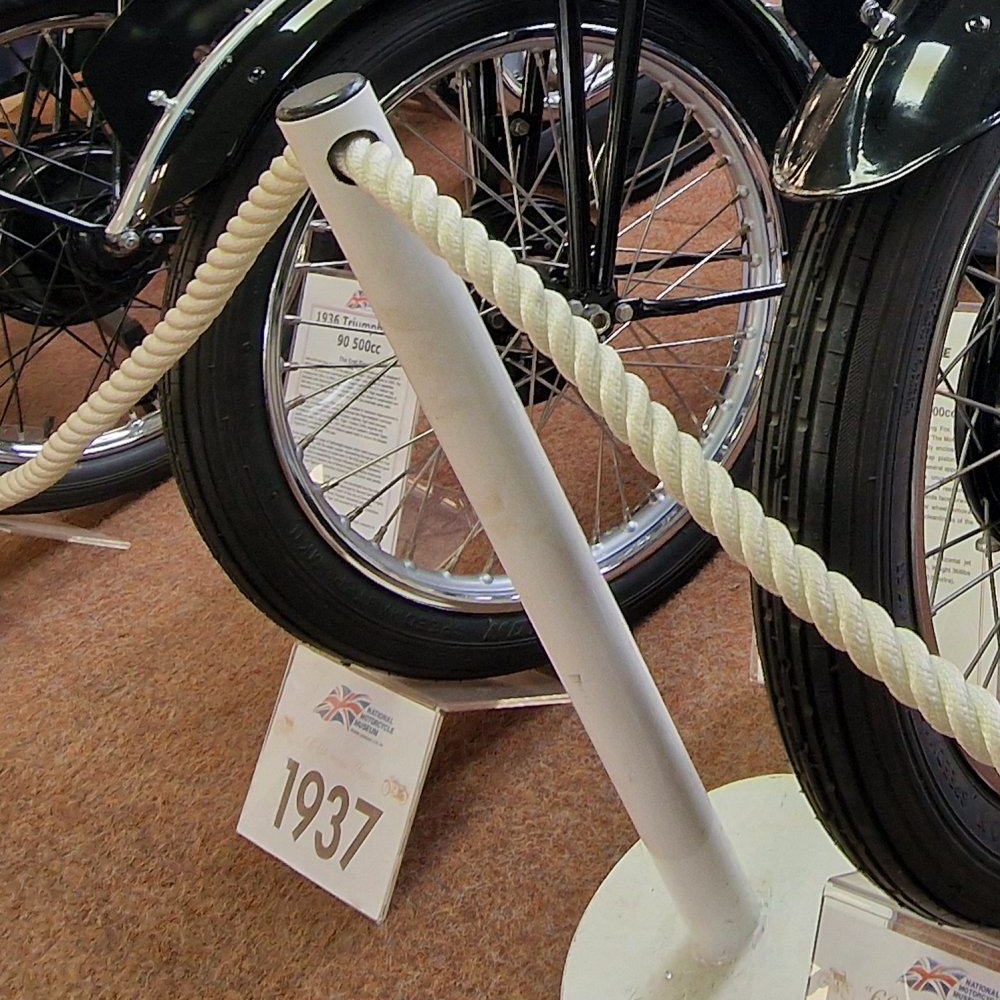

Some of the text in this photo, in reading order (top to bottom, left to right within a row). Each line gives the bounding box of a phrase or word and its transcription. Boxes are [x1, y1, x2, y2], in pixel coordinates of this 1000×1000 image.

[337, 334, 381, 355] 90 500cc
[361, 713, 394, 735] MOTORCYCLE
[367, 706, 393, 725] NATIONAL
[354, 719, 379, 737] MUSEUM
[274, 758, 384, 871] 1937
[966, 980, 999, 998] NATIONAL
